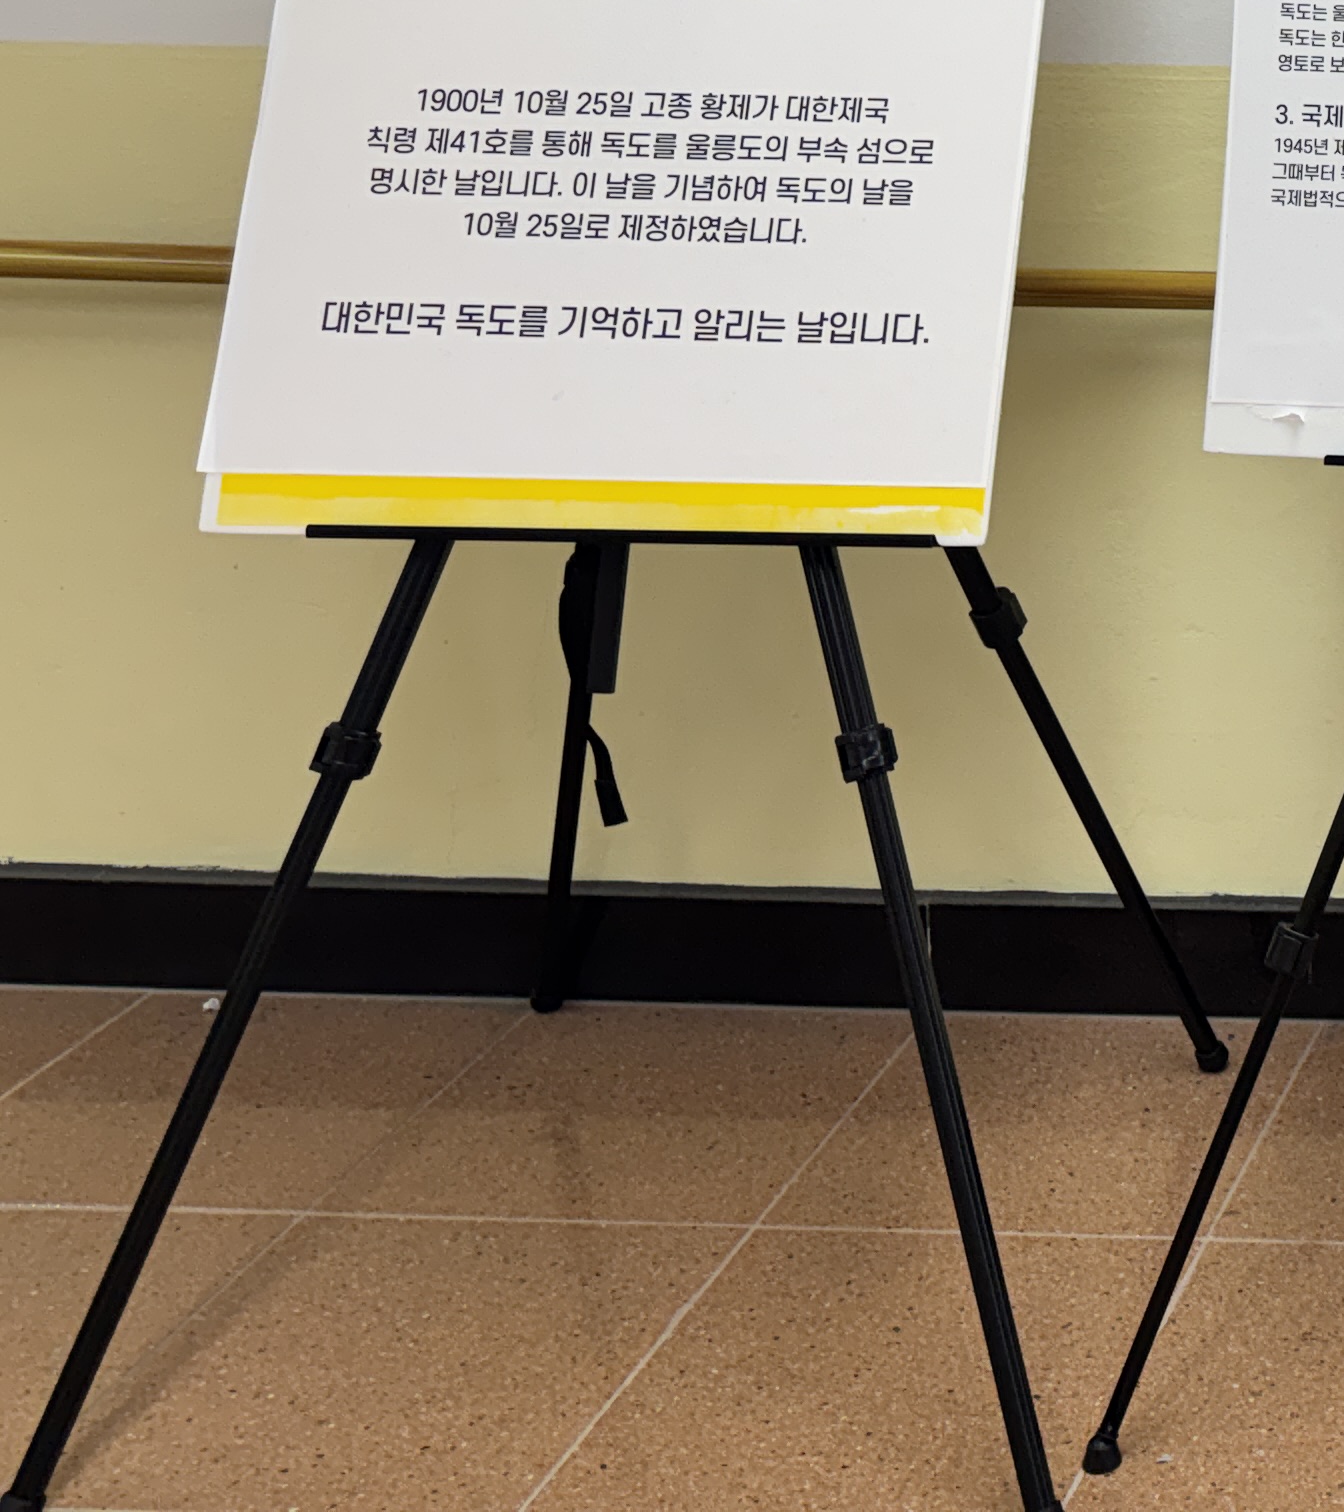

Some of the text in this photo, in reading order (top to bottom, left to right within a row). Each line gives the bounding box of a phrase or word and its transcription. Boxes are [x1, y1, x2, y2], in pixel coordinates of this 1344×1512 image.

[1280, 1, 1328, 23] 독도는
[1278, 27, 1327, 48] 독도는
[1278, 53, 1325, 74] 영토로
[417, 87, 890, 125] 1900년 10월 25일 고종 황제가 대한제국
[1274, 103, 1294, 126] 3.
[367, 125, 934, 166] 칙령 제41호를 통해 독도를 울릉도의 부속 섬으로
[1274, 136, 1329, 157] 1945년
[1271, 161, 1335, 183] 그때부터
[370, 166, 914, 207] 명시한 날입니다. 이 날을 기념하여 독도의 날을
[464, 210, 807, 246] 10월 25일로 제정하였습니다.
[321, 299, 929, 346] 대한민국 독도를 기억하고 알리는 날입니다.
